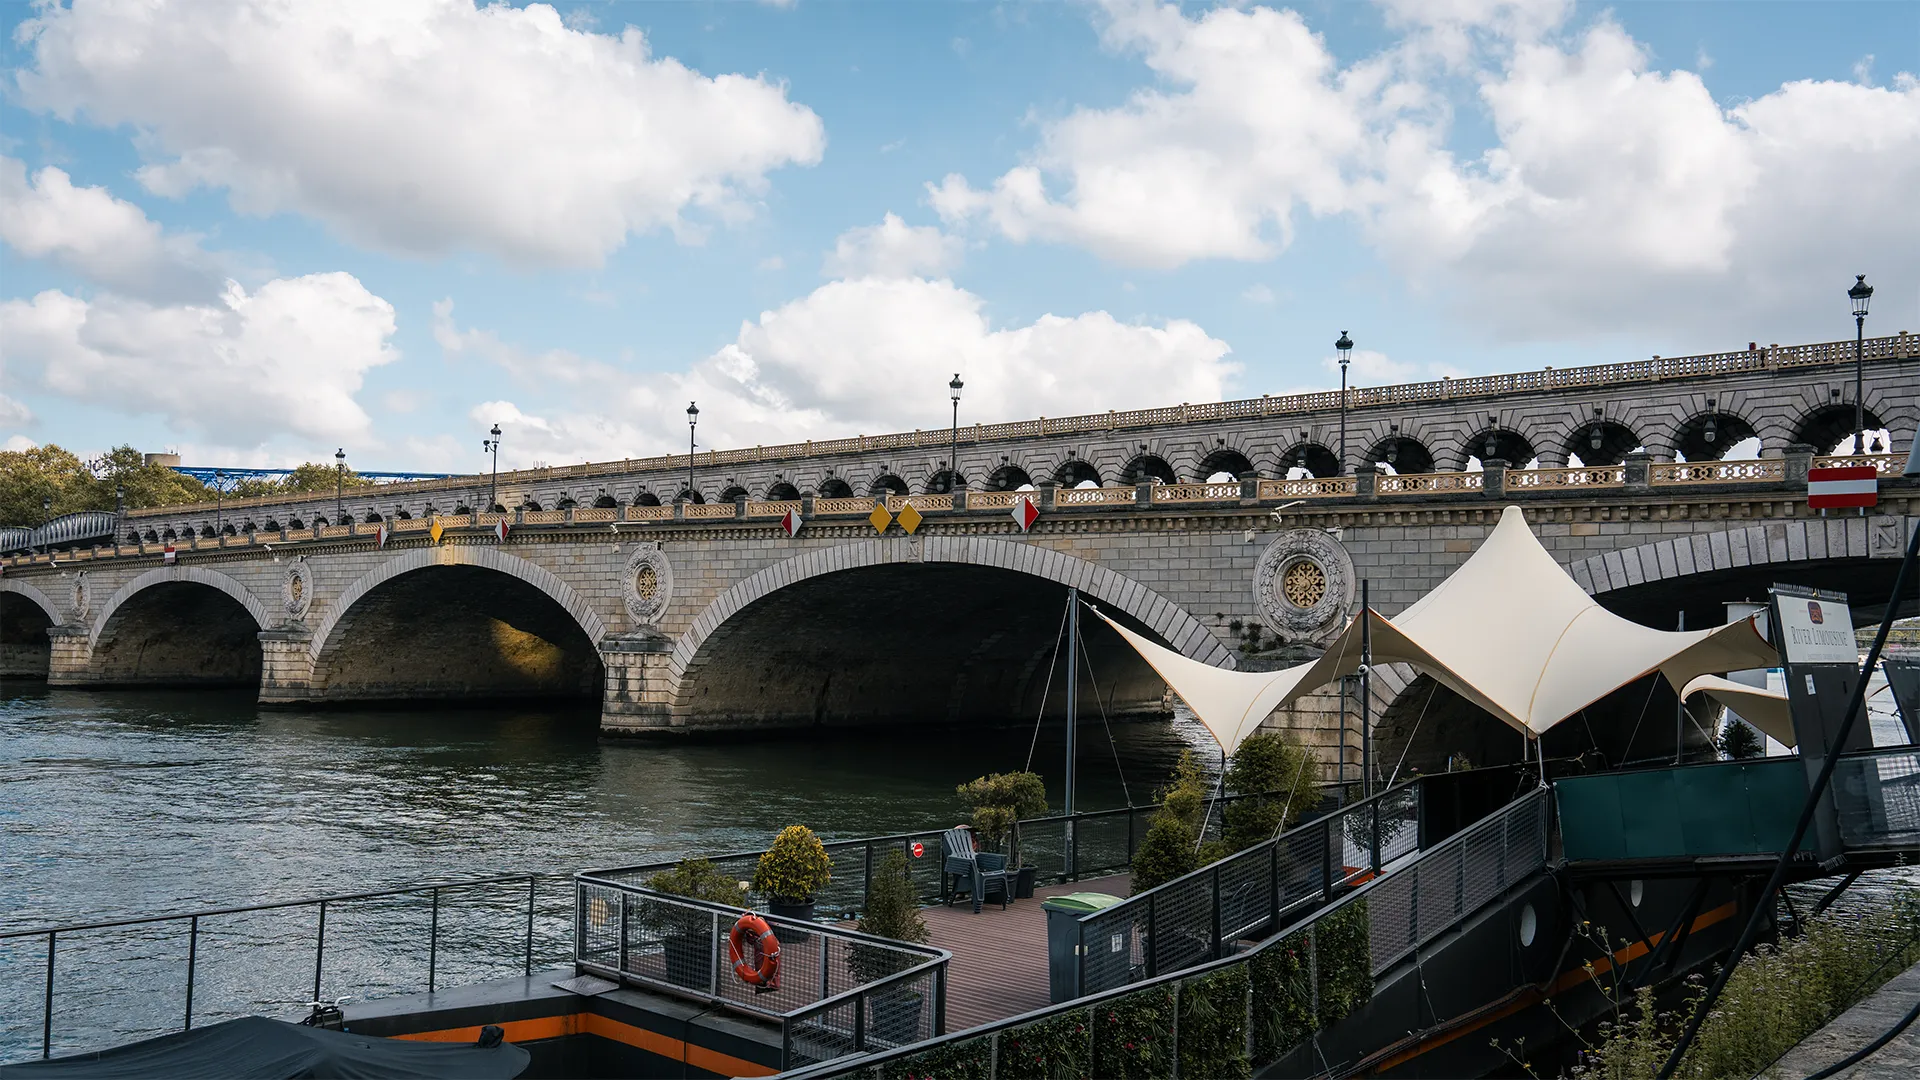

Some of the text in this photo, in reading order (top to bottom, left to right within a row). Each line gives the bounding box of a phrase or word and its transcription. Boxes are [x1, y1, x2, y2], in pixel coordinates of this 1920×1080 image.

[1874, 526, 1898, 549] N
[1791, 626, 1848, 646] RIVER LIMOUSINE
